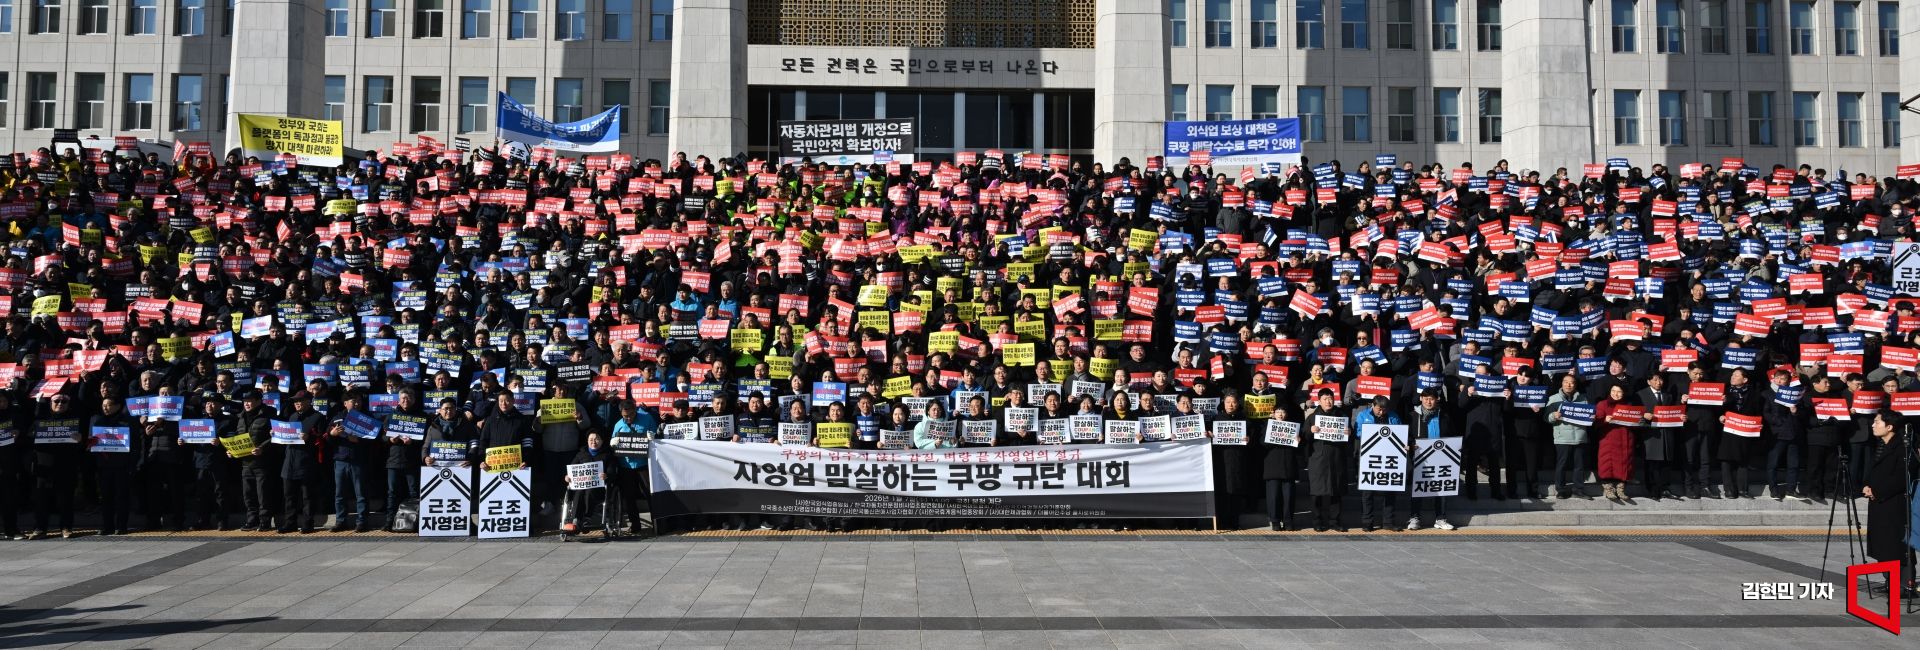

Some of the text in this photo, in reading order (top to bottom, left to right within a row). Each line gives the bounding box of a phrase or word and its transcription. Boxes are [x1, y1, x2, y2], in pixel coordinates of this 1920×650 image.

[781, 57, 1058, 74] 모든 권력은 국민으로부터 나온다
[279, 119, 328, 132] 정부와 국회는
[781, 122, 912, 138] 자동차관리법 개정으로
[1187, 123, 1277, 137] 외식업 보상 대책은
[252, 127, 290, 140] 플랫폼의
[294, 132, 323, 143] 독과점과
[266, 140, 284, 151] 방지
[288, 142, 304, 153] 대책
[792, 138, 901, 153] 국민안전 확보하자!
[1168, 141, 1190, 153] 쿠팡
[1192, 140, 1245, 153] 배달수수료
[1247, 139, 1269, 150] 즉각
[781, 449, 822, 461] 쿠팡의
[976, 450, 990, 463] 끝
[995, 449, 1049, 463] 자영업의
[1055, 449, 1082, 462] 절규
[734, 460, 1130, 491] 자영업 말살하는 쿠팡 규탄 대회
[1361, 472, 1404, 486] 자영업
[1414, 479, 1457, 493] 자영업
[422, 516, 467, 531] 자영업
[481, 517, 527, 533] 자영업
